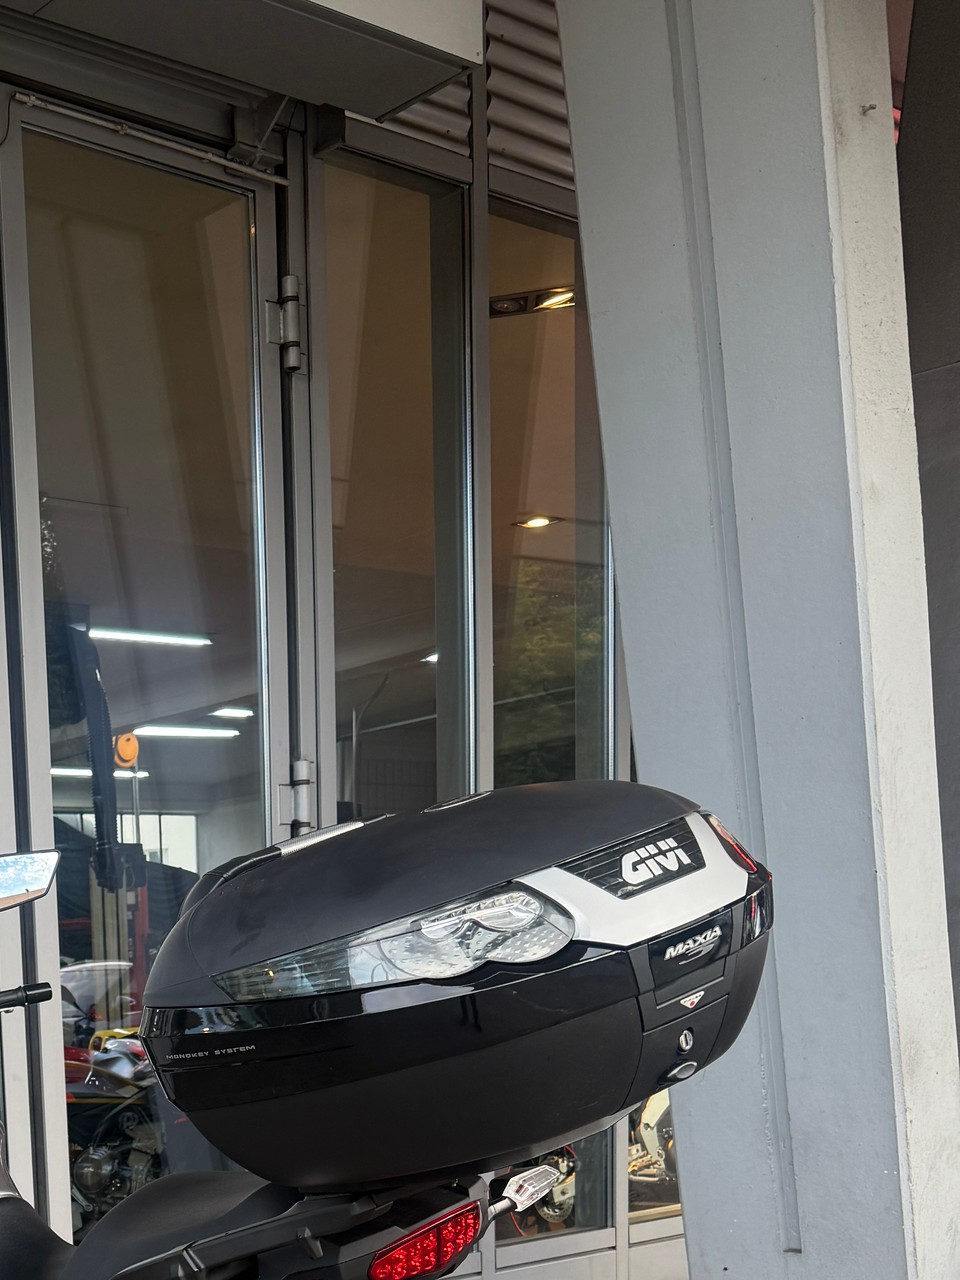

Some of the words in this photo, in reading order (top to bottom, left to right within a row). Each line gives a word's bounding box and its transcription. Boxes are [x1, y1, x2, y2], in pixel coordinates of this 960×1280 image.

[621, 837, 692, 885] GIVI
[663, 925, 722, 961] MAXIA
[165, 1051, 209, 1060] MONOKEY
[214, 1045, 256, 1056] SYSTEM
